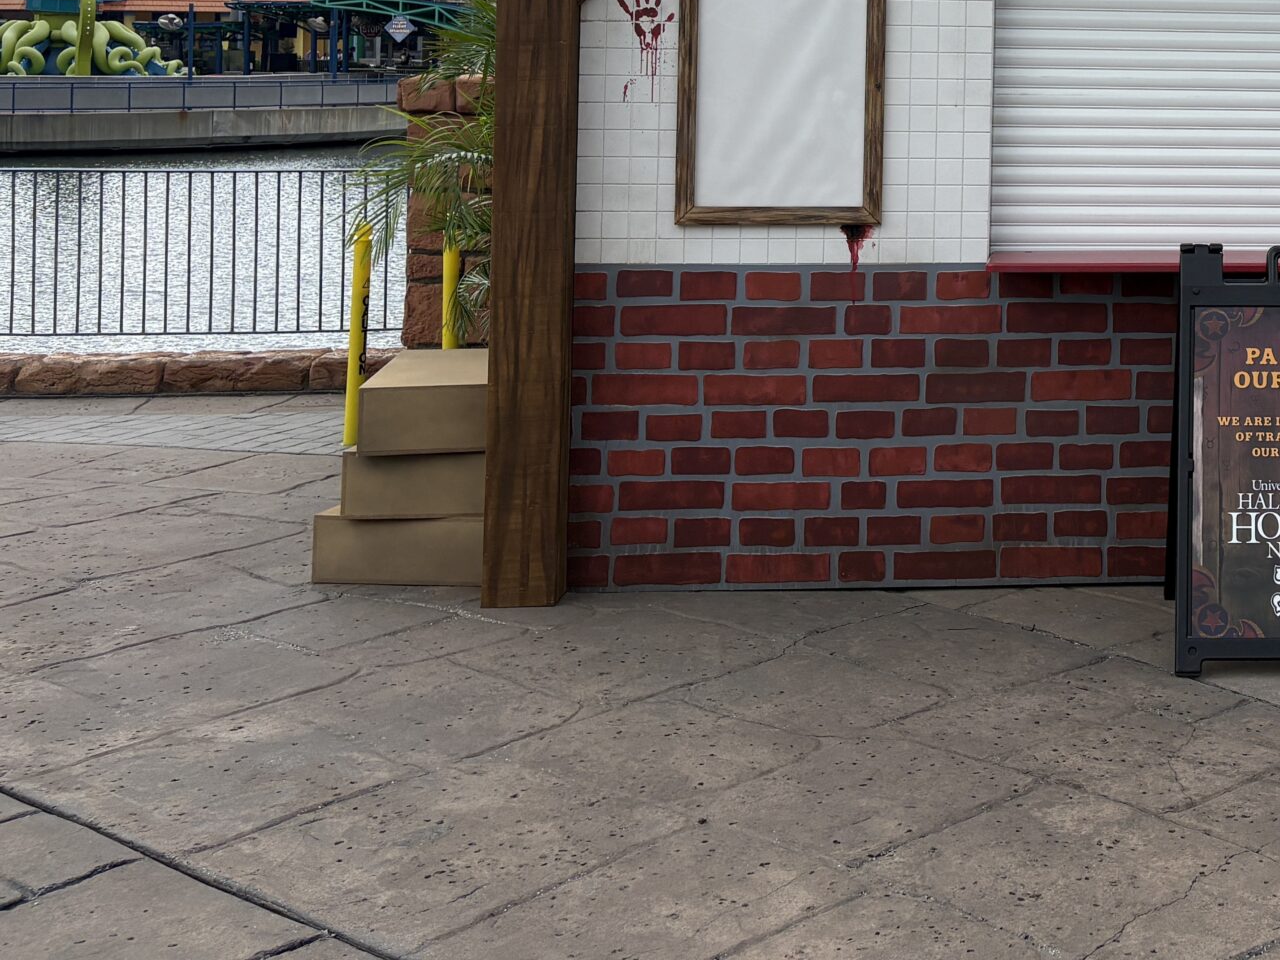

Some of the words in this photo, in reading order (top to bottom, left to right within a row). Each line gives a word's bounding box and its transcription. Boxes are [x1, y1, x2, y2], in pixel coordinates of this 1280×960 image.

[358, 294, 370, 376] CAUTION
[1217, 416, 1240, 426] WE
[1243, 416, 1272, 426] ARE
[1235, 431, 1253, 442] OF
[1251, 447, 1280, 457] OUR
